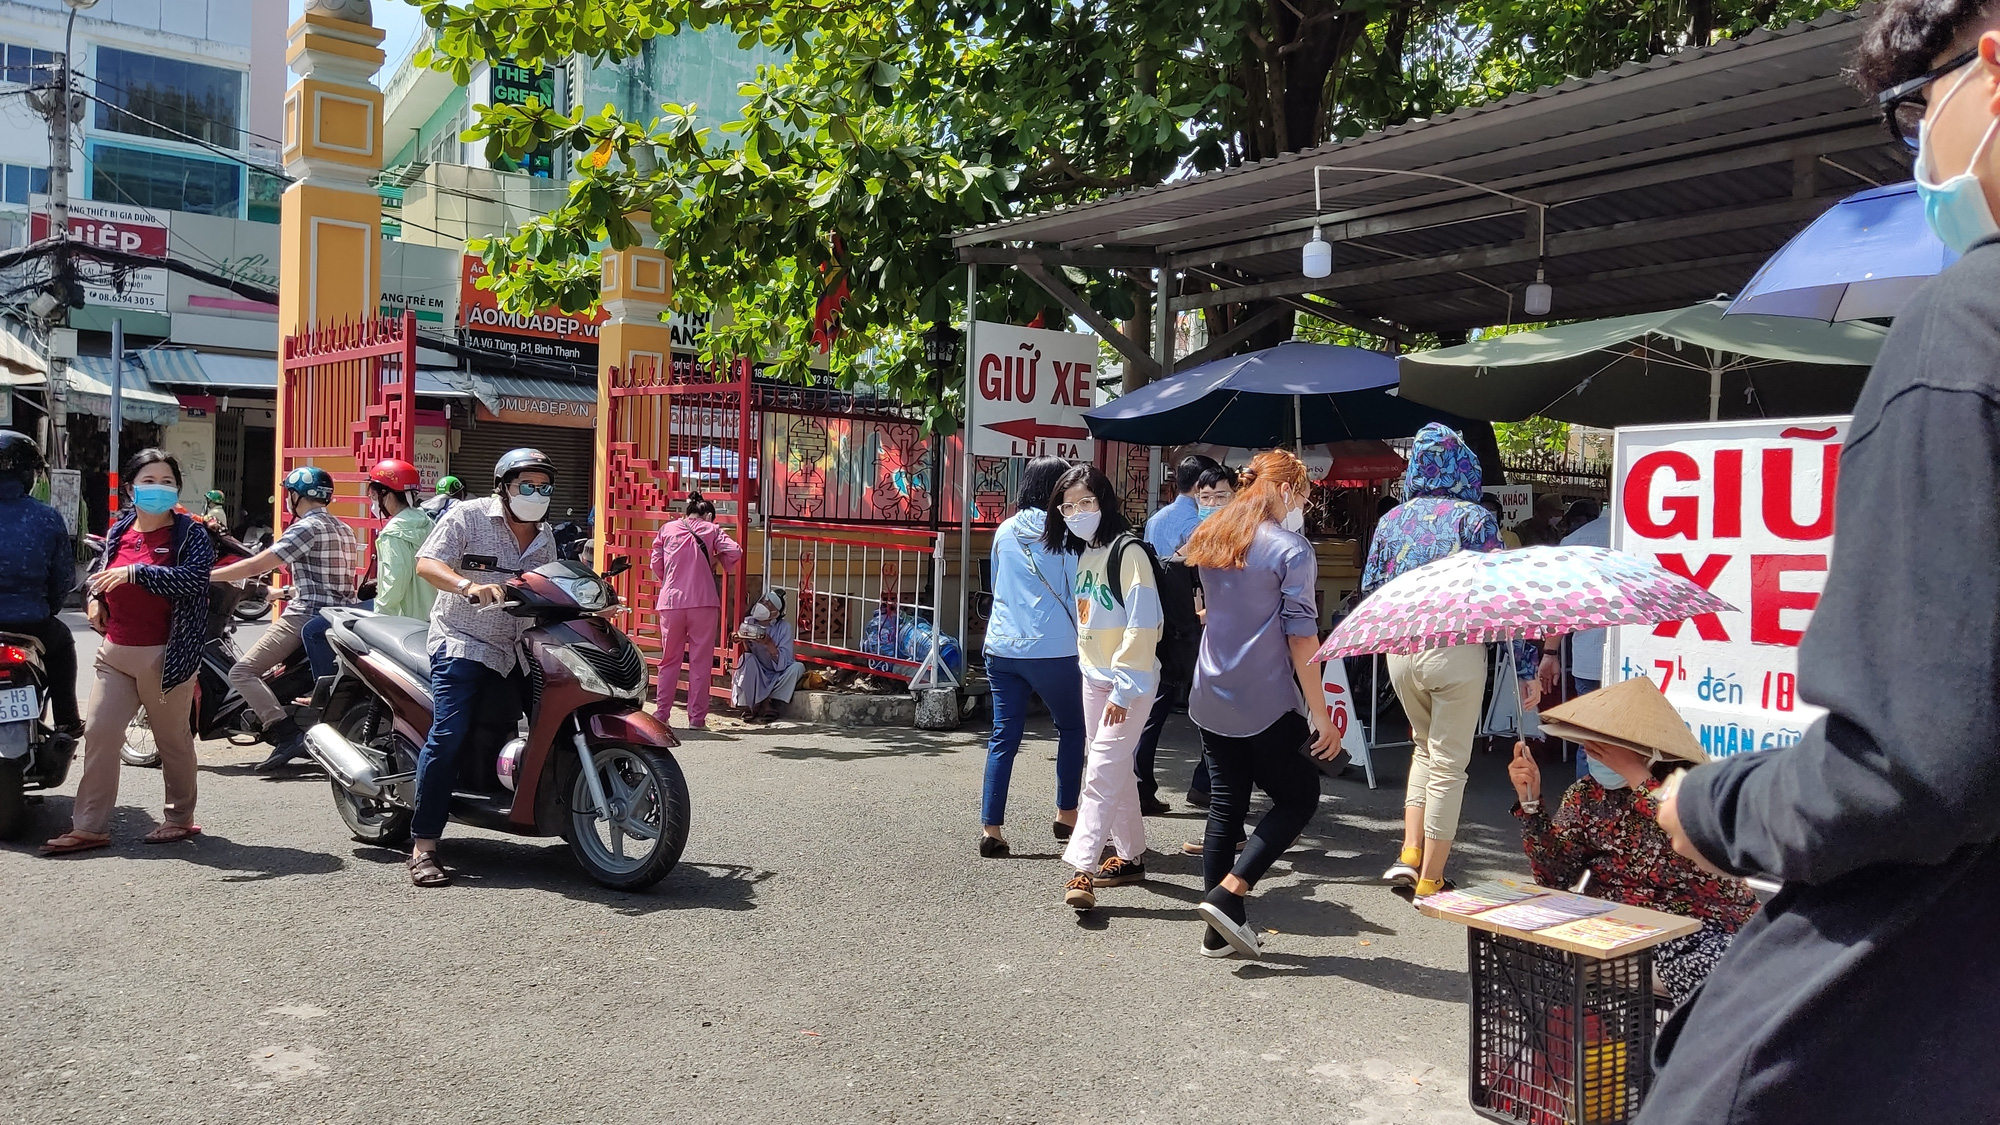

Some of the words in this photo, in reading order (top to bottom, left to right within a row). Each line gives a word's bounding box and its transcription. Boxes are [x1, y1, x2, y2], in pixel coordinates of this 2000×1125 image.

[496, 65, 530, 84] THE
[85, 207, 108, 218] THIẾT
[110, 210, 118, 220] BỊ
[120, 211, 133, 221] GIA
[134, 213, 156, 224] DỤNG
[134, 296, 155, 306] 3015
[428, 298, 444, 308] EM
[535, 343, 554, 356] Bình
[554, 346, 580, 360] Thạnh
[978, 342, 1042, 404] GIỮ
[1050, 360, 1092, 408] XE
[1057, 443, 1079, 459] RA
[1502, 490, 1529, 506] KHÁCH
[1697, 667, 1743, 705] đến
[1700, 722, 1755, 758] NHÂN
